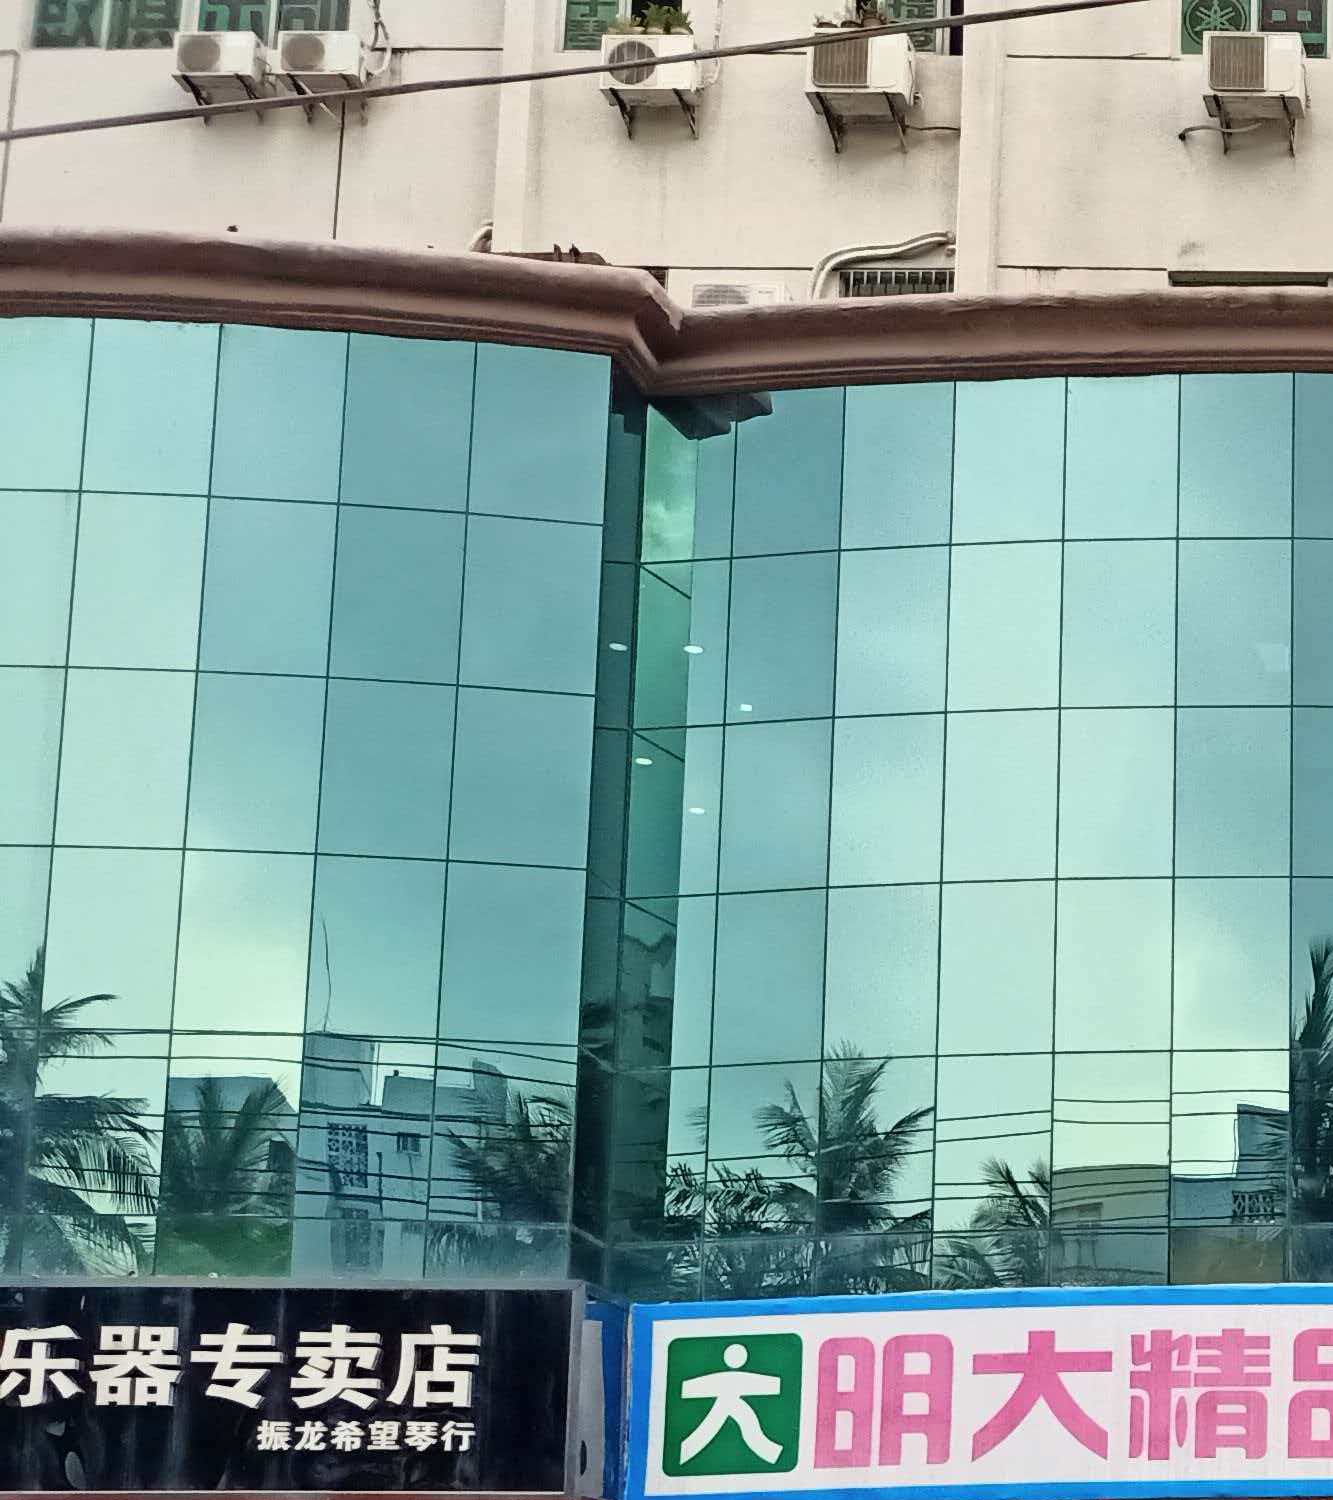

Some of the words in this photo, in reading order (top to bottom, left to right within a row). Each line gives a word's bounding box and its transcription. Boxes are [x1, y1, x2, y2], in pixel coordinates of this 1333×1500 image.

[0, 1324, 481, 1410] 乐器专卖店
[257, 1419, 475, 1453] 振龙希望琴行
